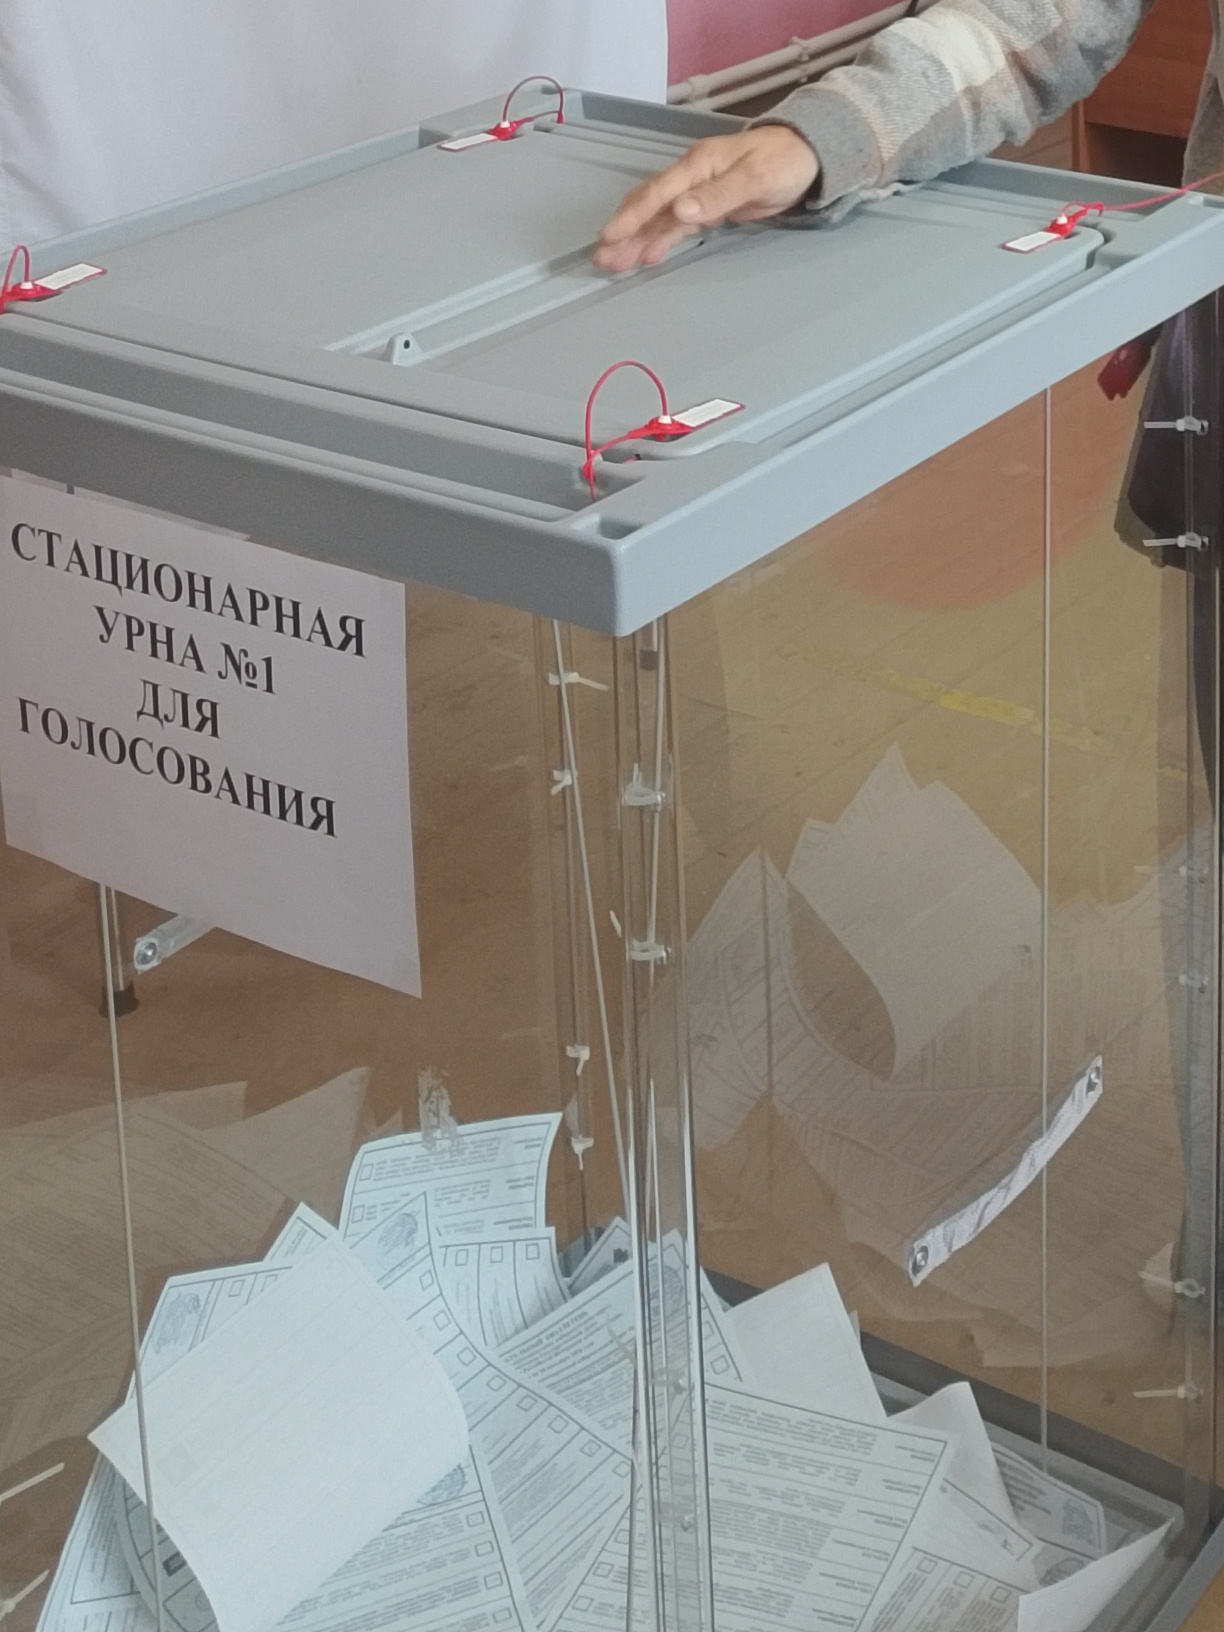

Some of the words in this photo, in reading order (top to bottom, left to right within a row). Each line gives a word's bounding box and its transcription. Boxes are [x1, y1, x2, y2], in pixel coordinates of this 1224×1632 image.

[10, 522, 368, 659] СТАЦИОНАРНАЯ
[92, 604, 207, 675] УРНА
[217, 641, 277, 695] №1
[136, 678, 222, 739] ДЛЯ
[17, 696, 338, 838] ГОЛОСОВАНИЯ
